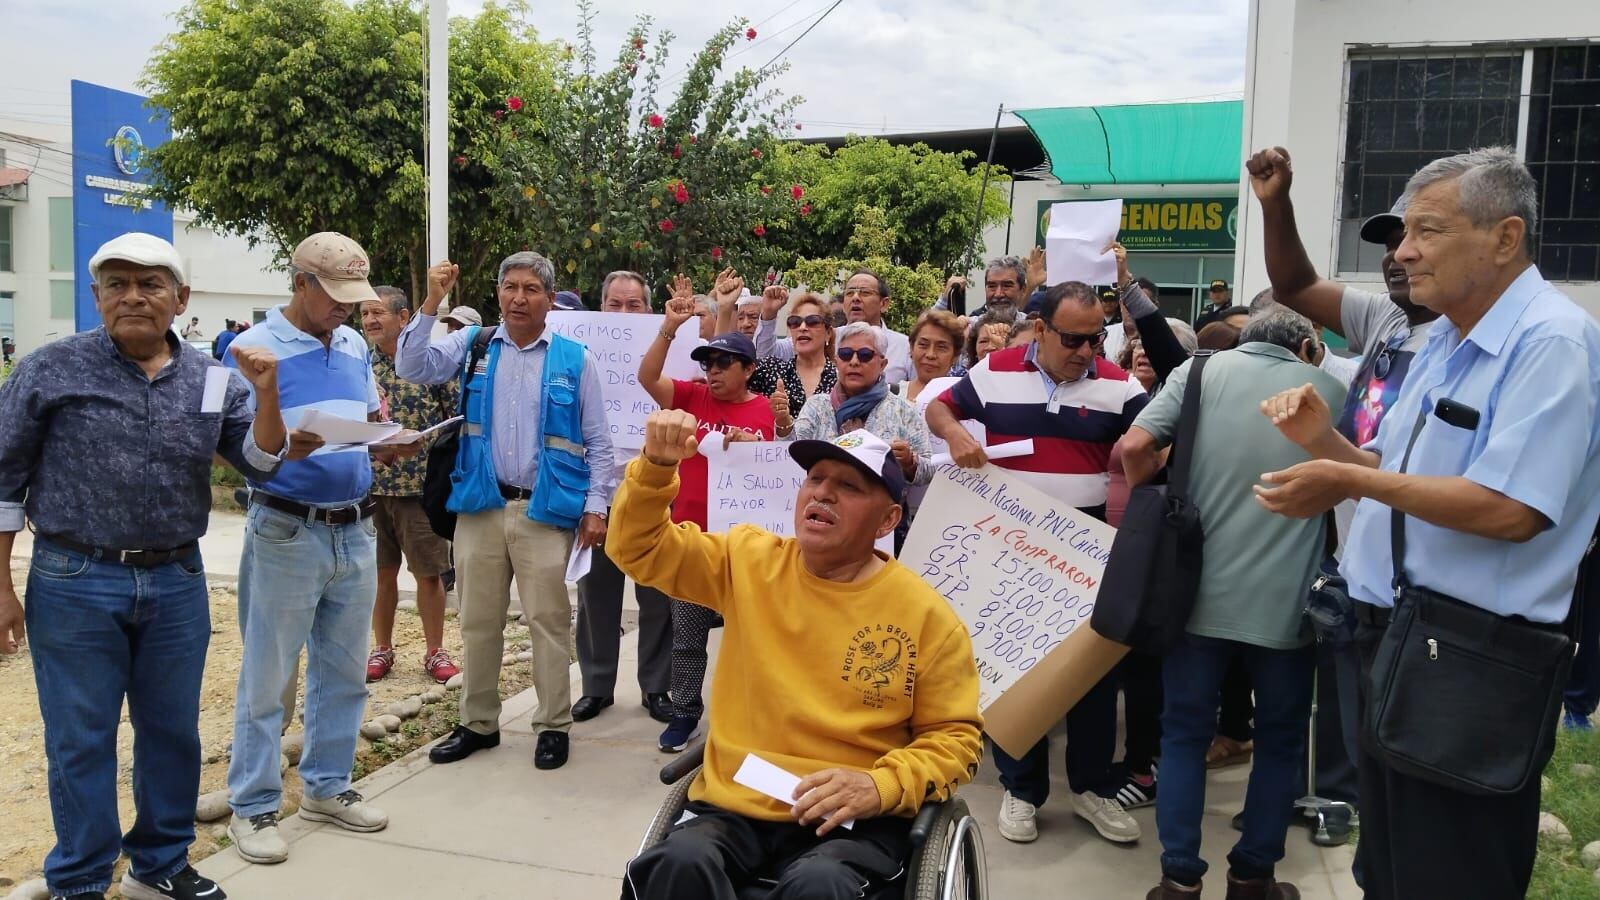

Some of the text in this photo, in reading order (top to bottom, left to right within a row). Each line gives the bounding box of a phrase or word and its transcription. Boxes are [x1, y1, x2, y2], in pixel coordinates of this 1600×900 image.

[1120, 202, 1223, 231] GENCIAS
[606, 369, 636, 386] DIG
[631, 401, 659, 415] MEN
[717, 472, 733, 490] LA
[743, 474, 784, 491] SALUD
[719, 498, 766, 510] FAVOR
[937, 463, 993, 499] HOSPITAL
[989, 483, 1037, 527] REGIONAL
[1068, 528, 1112, 567] CHICLA
[973, 514, 1097, 590] LA COMPRARON
[843, 645, 857, 672] ROSE
[853, 626, 872, 644] FOR
[875, 623, 882, 632] A
[886, 624, 917, 659] BROKEN
[903, 663, 916, 698] HEART
